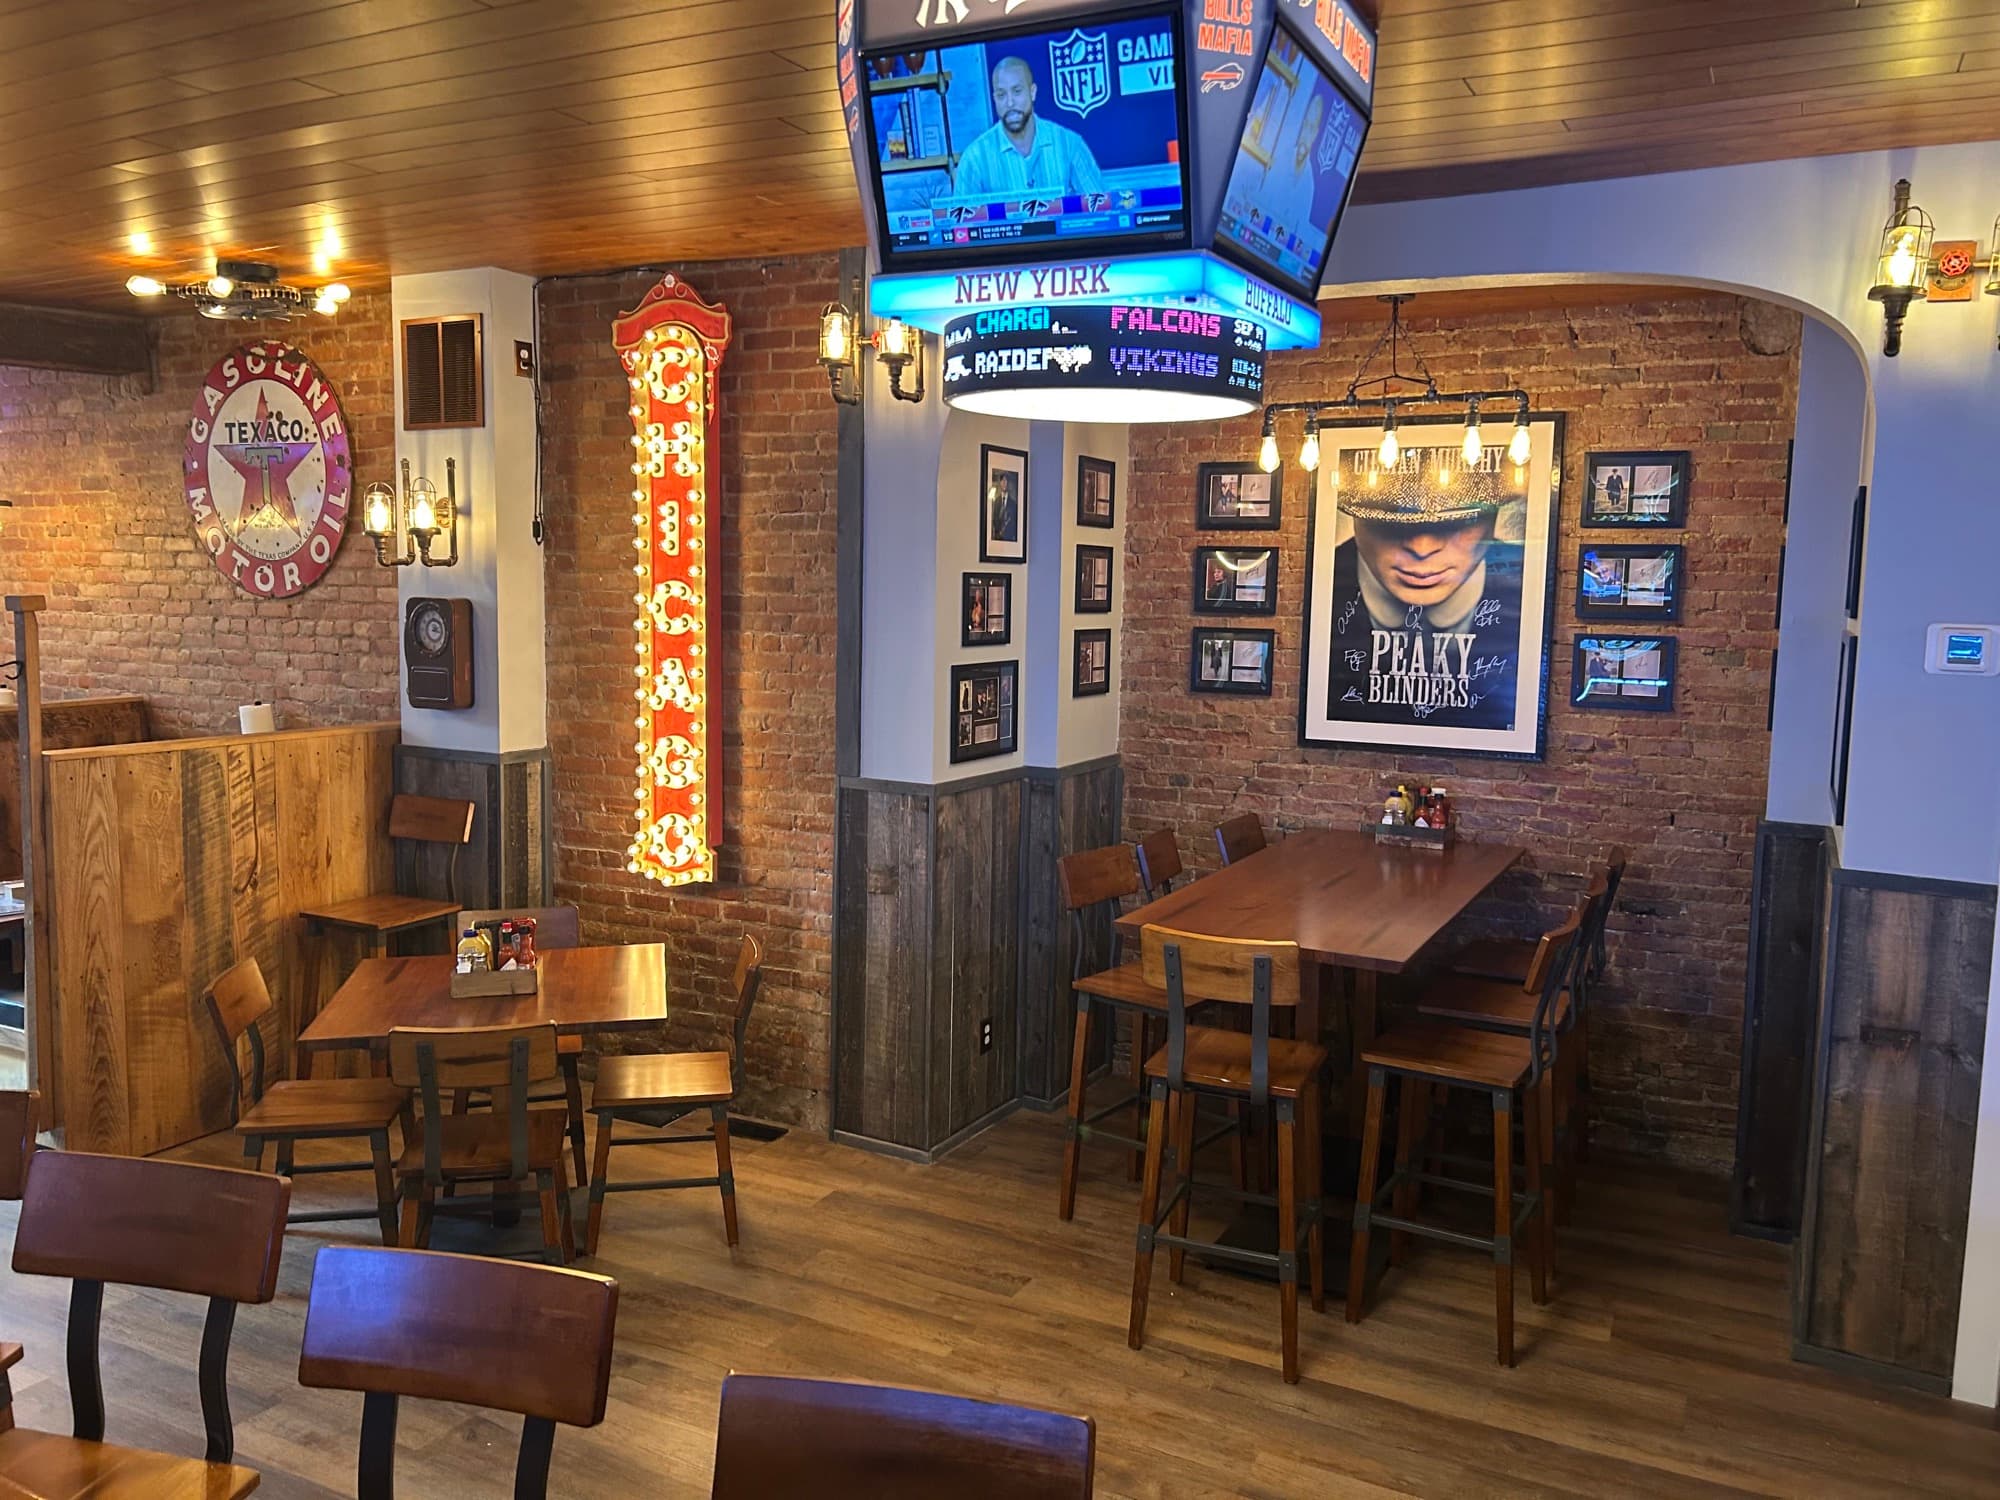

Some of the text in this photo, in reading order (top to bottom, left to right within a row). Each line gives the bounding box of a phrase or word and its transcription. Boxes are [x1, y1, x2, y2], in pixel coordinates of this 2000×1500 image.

[1204, 0, 1253, 25] BILLS
[1197, 23, 1253, 56] MAFIA
[1058, 66, 1104, 103] NFL
[955, 263, 1110, 304] NEW YORK
[1245, 278, 1293, 325] BUFFALO
[1110, 306, 1221, 338] FALCONS
[1109, 347, 1219, 378] VIKINGS
[191, 345, 343, 444] GASOLINE
[224, 419, 304, 444] TEXACO
[1429, 446, 1505, 475] MURHY
[188, 486, 302, 593] MOTOR
[309, 485, 348, 564] OIL
[258, 550, 277, 559] TEXAS
[648, 345, 696, 868] CHICAGO
[1369, 629, 1477, 679] PEAKY
[1368, 674, 1469, 708] BLINDERS
